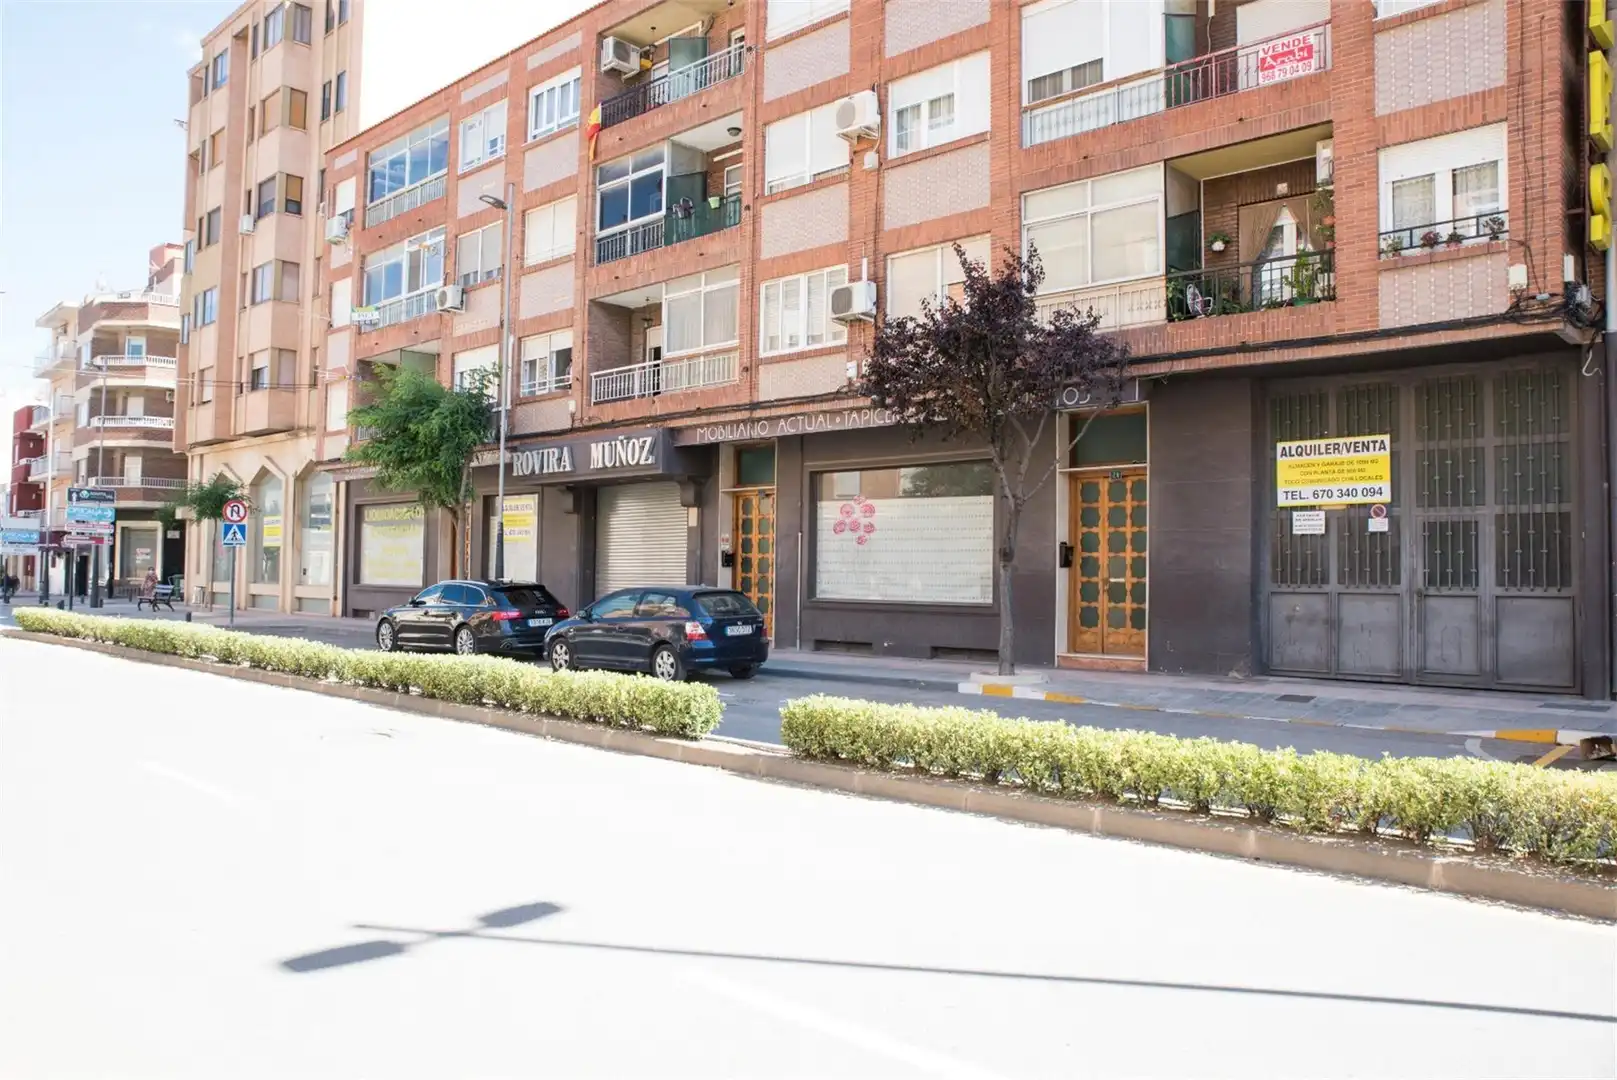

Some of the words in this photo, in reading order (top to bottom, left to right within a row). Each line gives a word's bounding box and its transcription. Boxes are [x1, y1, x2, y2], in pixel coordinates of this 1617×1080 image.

[1262, 35, 1311, 55] VENDE
[696, 420, 769, 443] MOBILIARIO
[777, 413, 833, 433] ACTUAL
[512, 447, 572, 477] ROVIRA
[590, 435, 656, 469] MUÑOZ
[1280, 439, 1387, 458] ALQUILER/VENTA
[1283, 490, 1309, 501] TEL.
[1312, 489, 1333, 499] 670
[1336, 488, 1358, 499] 340
[1361, 487, 1383, 497] 094
